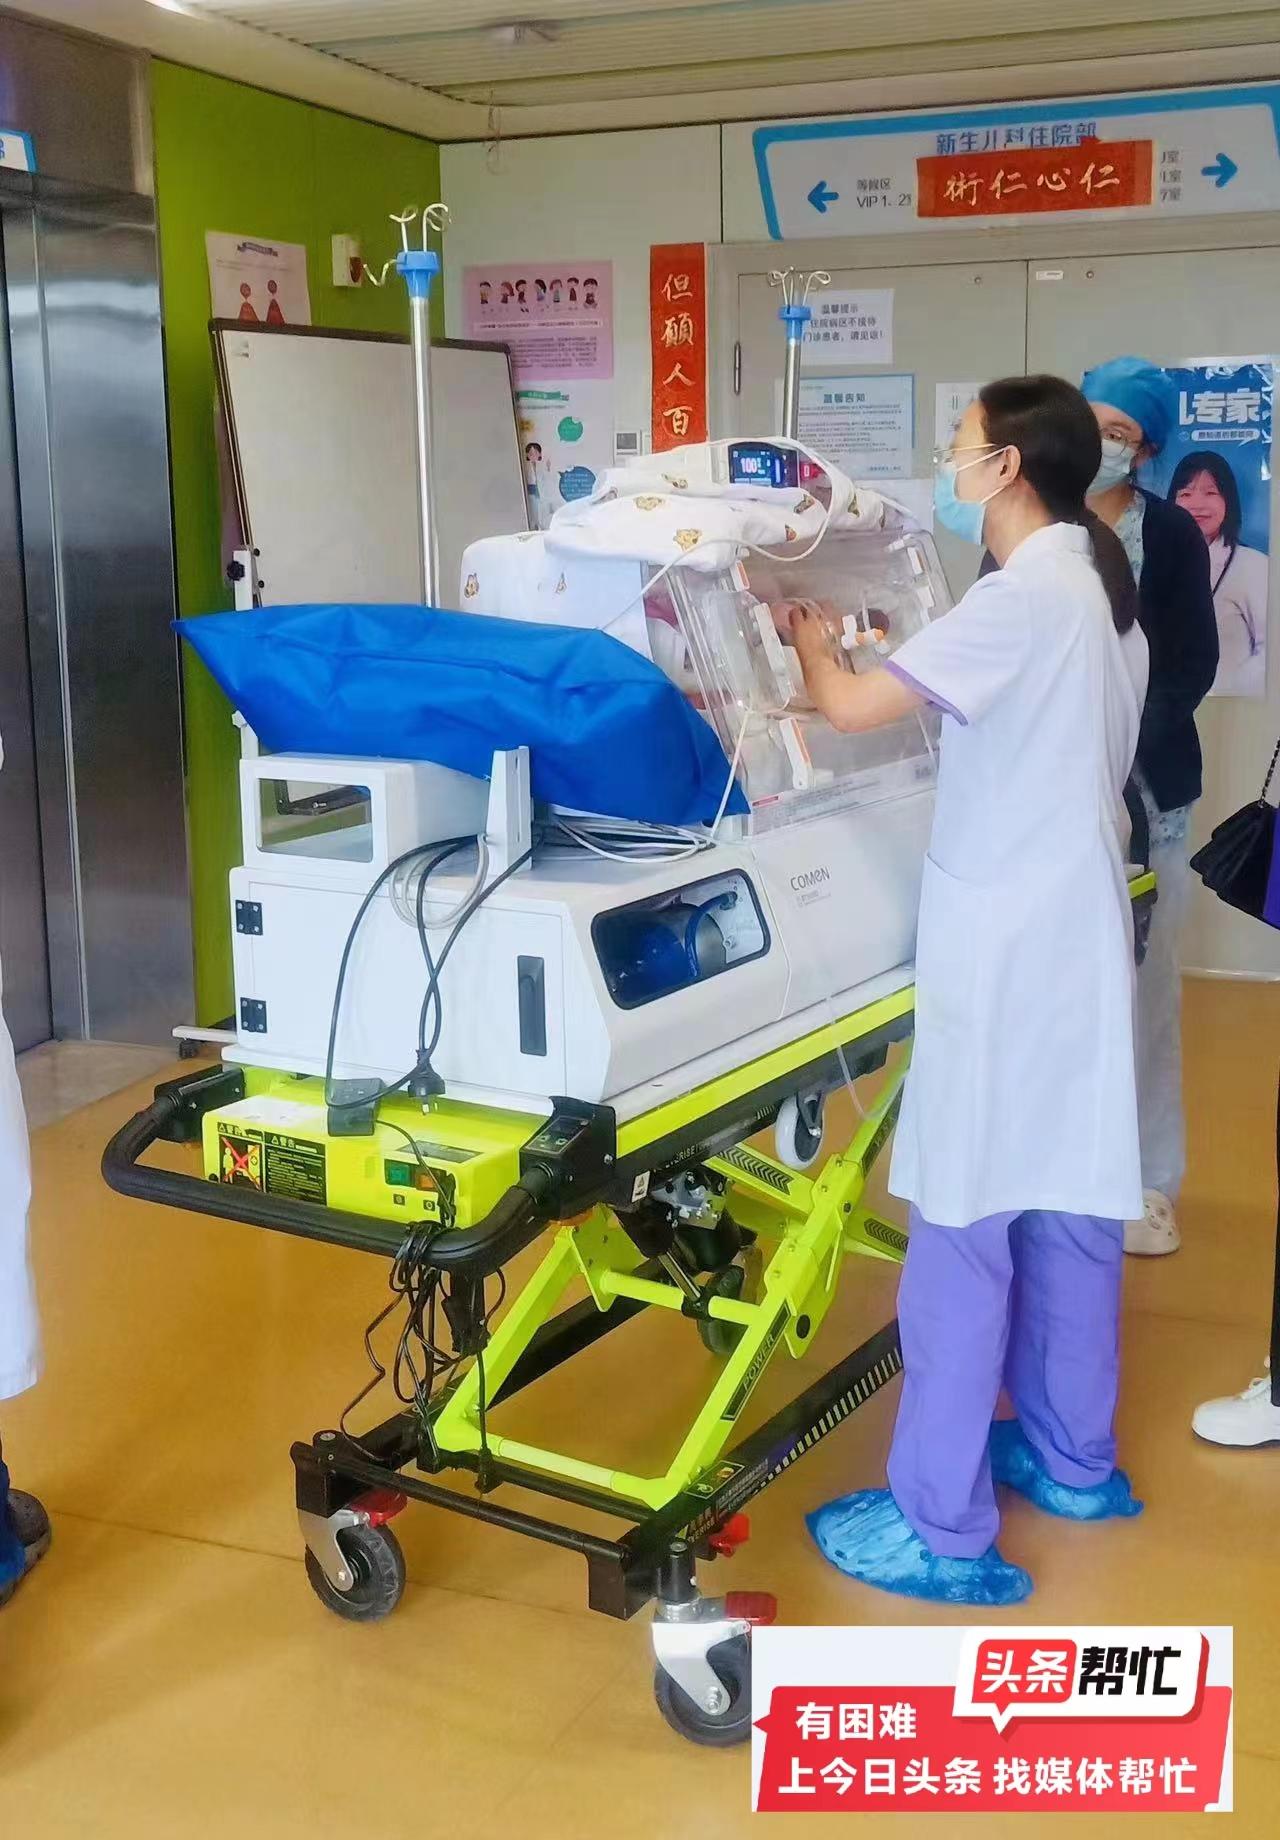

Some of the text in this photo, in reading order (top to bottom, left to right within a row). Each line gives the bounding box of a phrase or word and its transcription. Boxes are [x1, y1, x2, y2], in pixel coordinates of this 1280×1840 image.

[856, 195, 878, 208] VIP
[823, 393, 866, 404] 温馨告知
[742, 1334, 775, 1391] POWER
